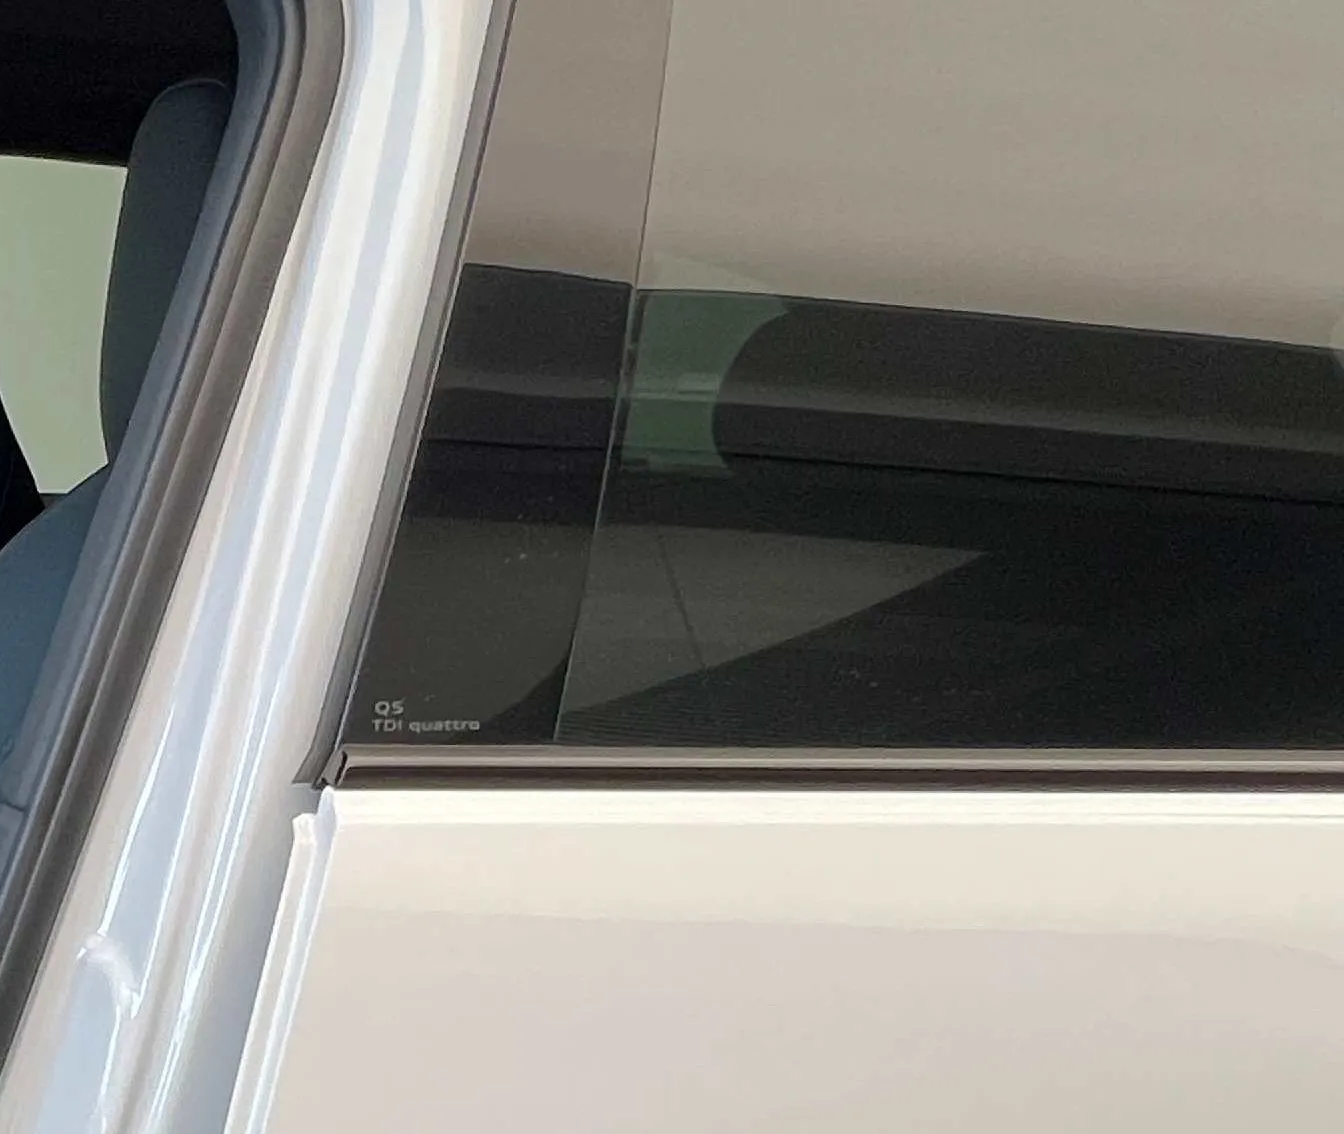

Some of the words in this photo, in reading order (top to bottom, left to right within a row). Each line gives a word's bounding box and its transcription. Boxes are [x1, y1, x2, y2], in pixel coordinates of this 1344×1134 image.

[374, 700, 404, 716] Q5
[372, 719, 402, 732] TDI
[408, 719, 481, 734] quattro
